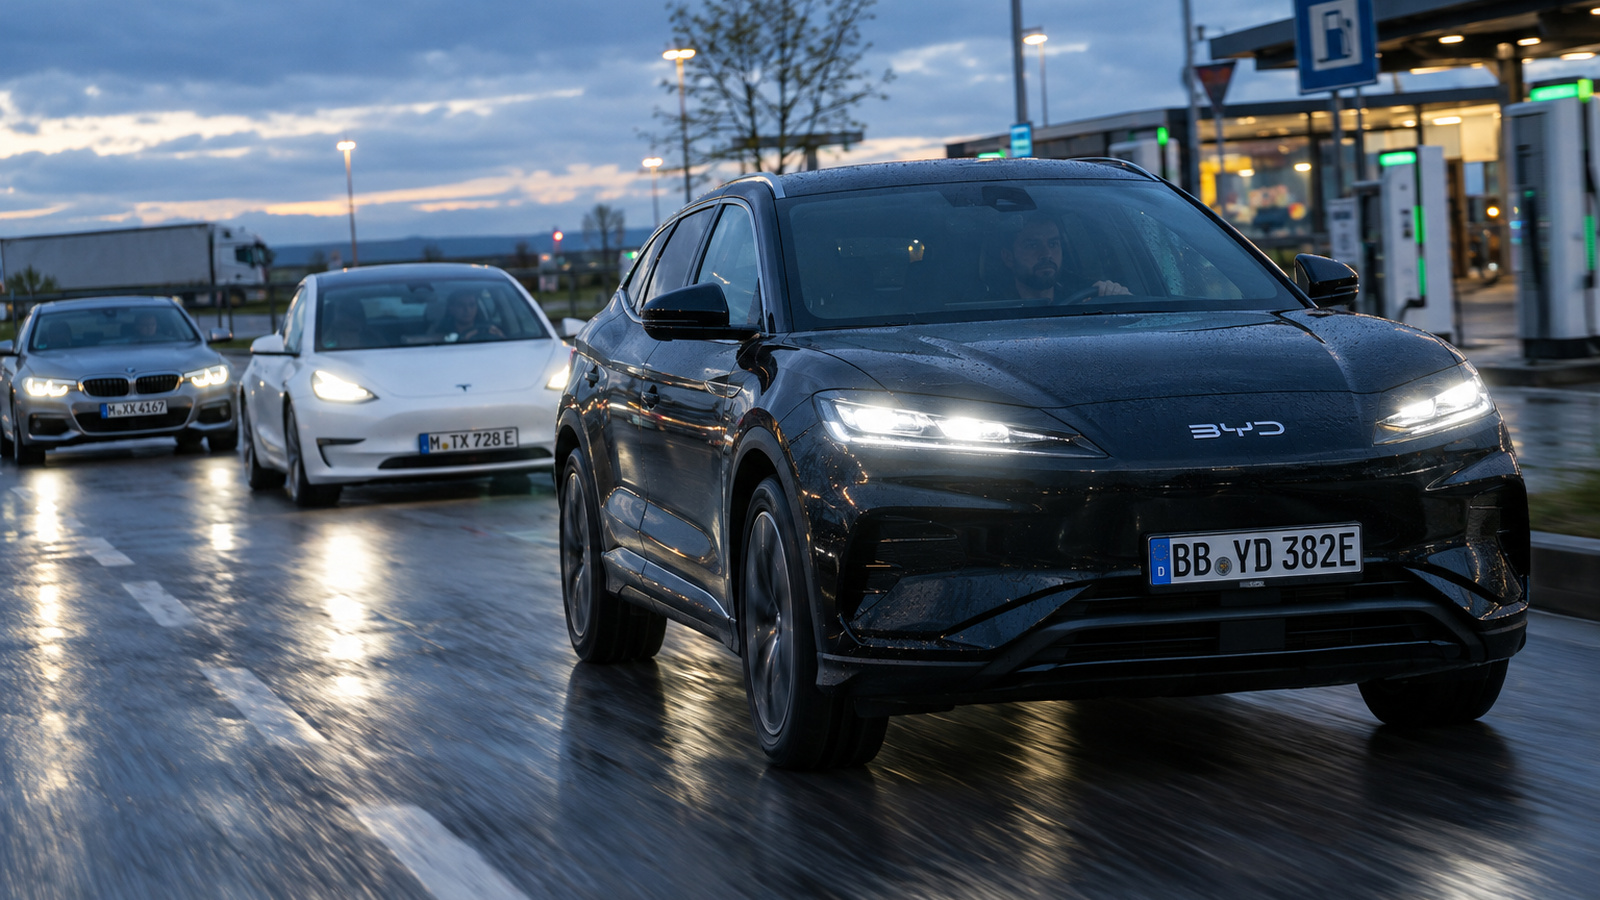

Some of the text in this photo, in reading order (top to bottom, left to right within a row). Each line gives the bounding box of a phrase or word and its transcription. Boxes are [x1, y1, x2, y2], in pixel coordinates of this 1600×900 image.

[108, 402, 164, 415] M XX 4167
[1188, 421, 1285, 439] BYD
[430, 436, 440, 450] M
[450, 434, 469, 449] TX
[1172, 532, 1356, 578] BB YD 382E
[1157, 566, 1165, 577] D
